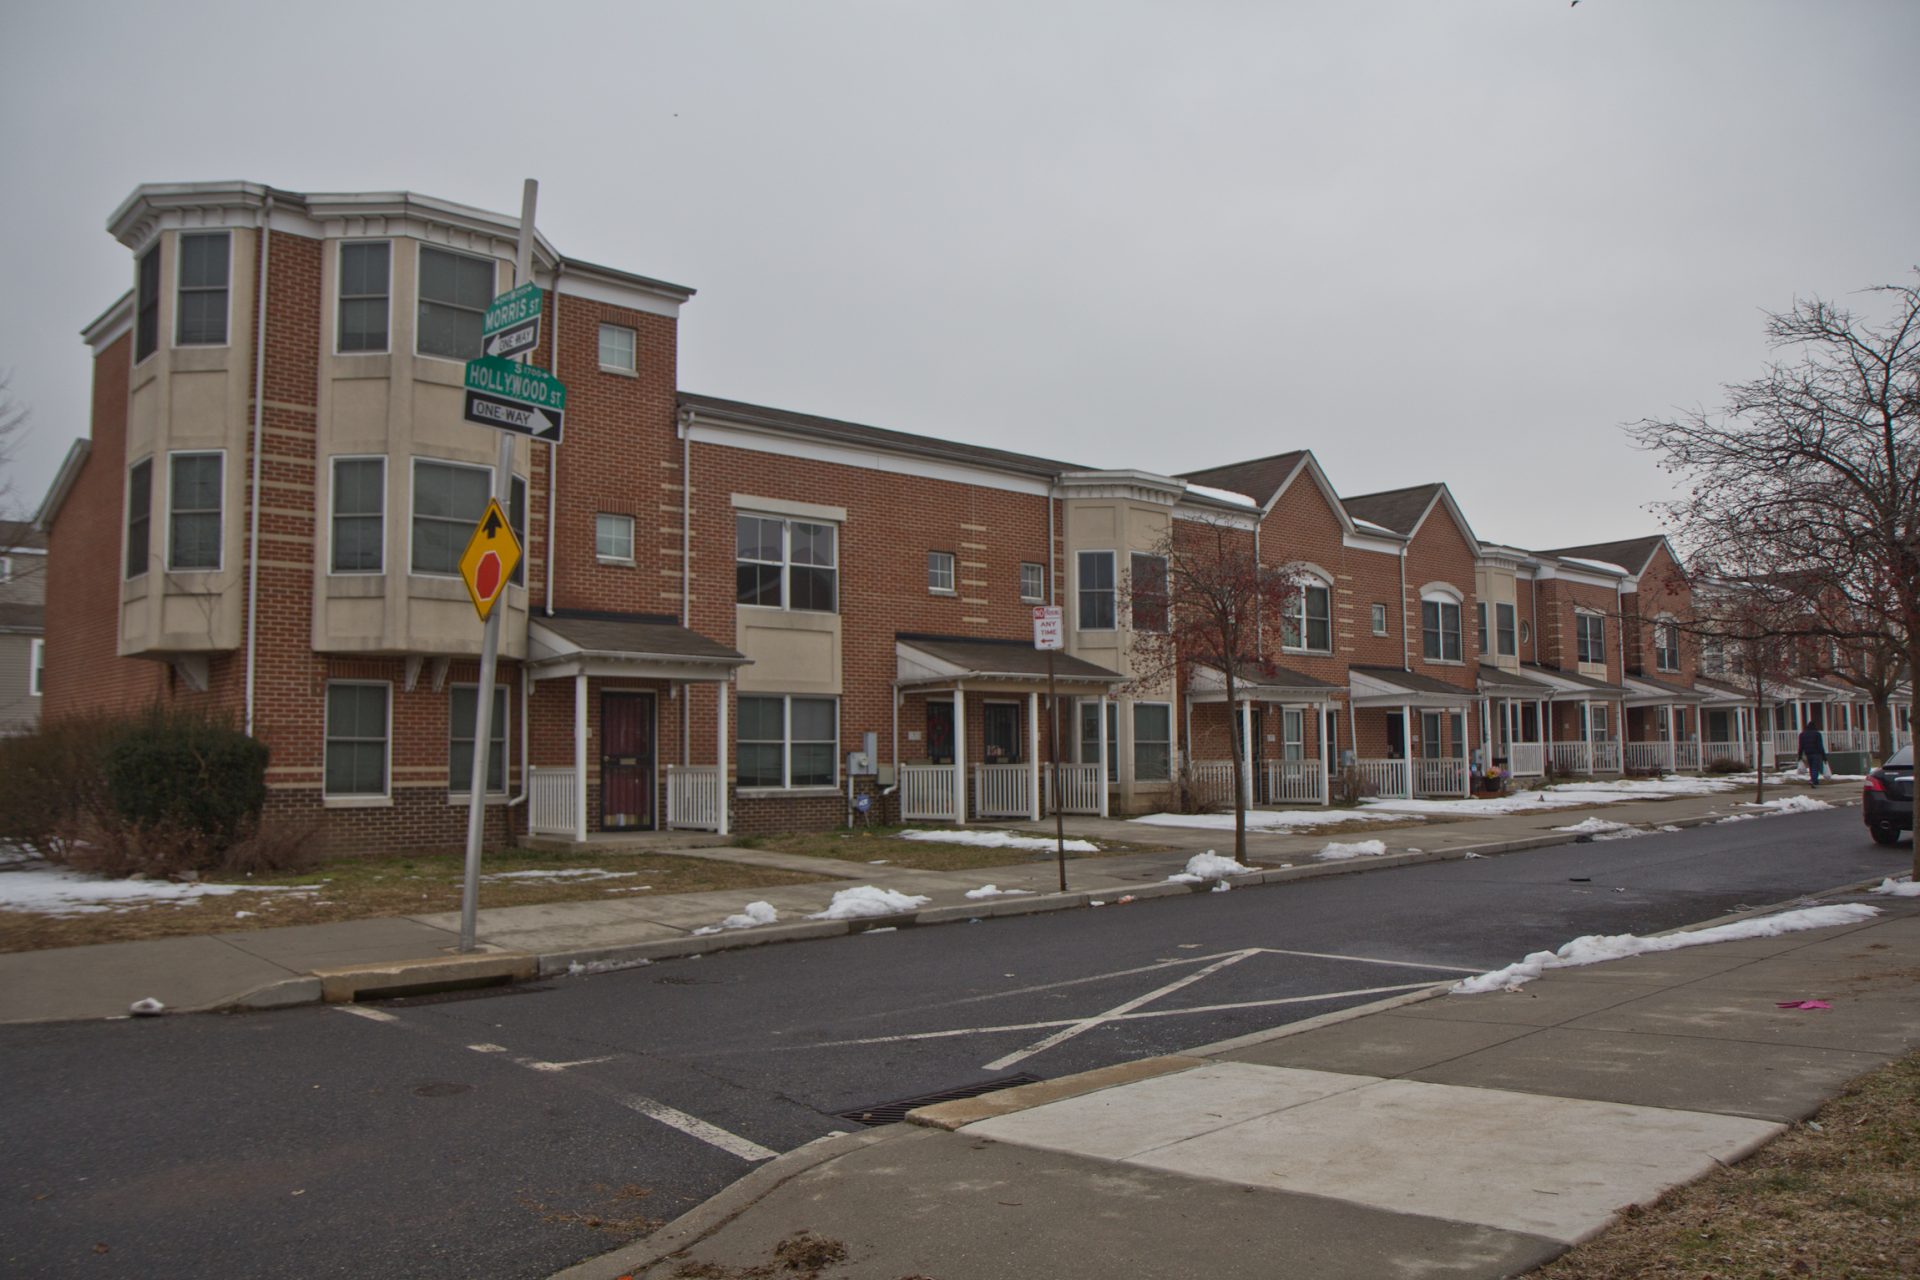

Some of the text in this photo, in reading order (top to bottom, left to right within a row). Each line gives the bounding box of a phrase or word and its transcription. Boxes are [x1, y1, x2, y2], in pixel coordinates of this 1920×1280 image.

[486, 298, 539, 331] MORRIS ST
[469, 365, 561, 405] HOLLYWOOD ST
